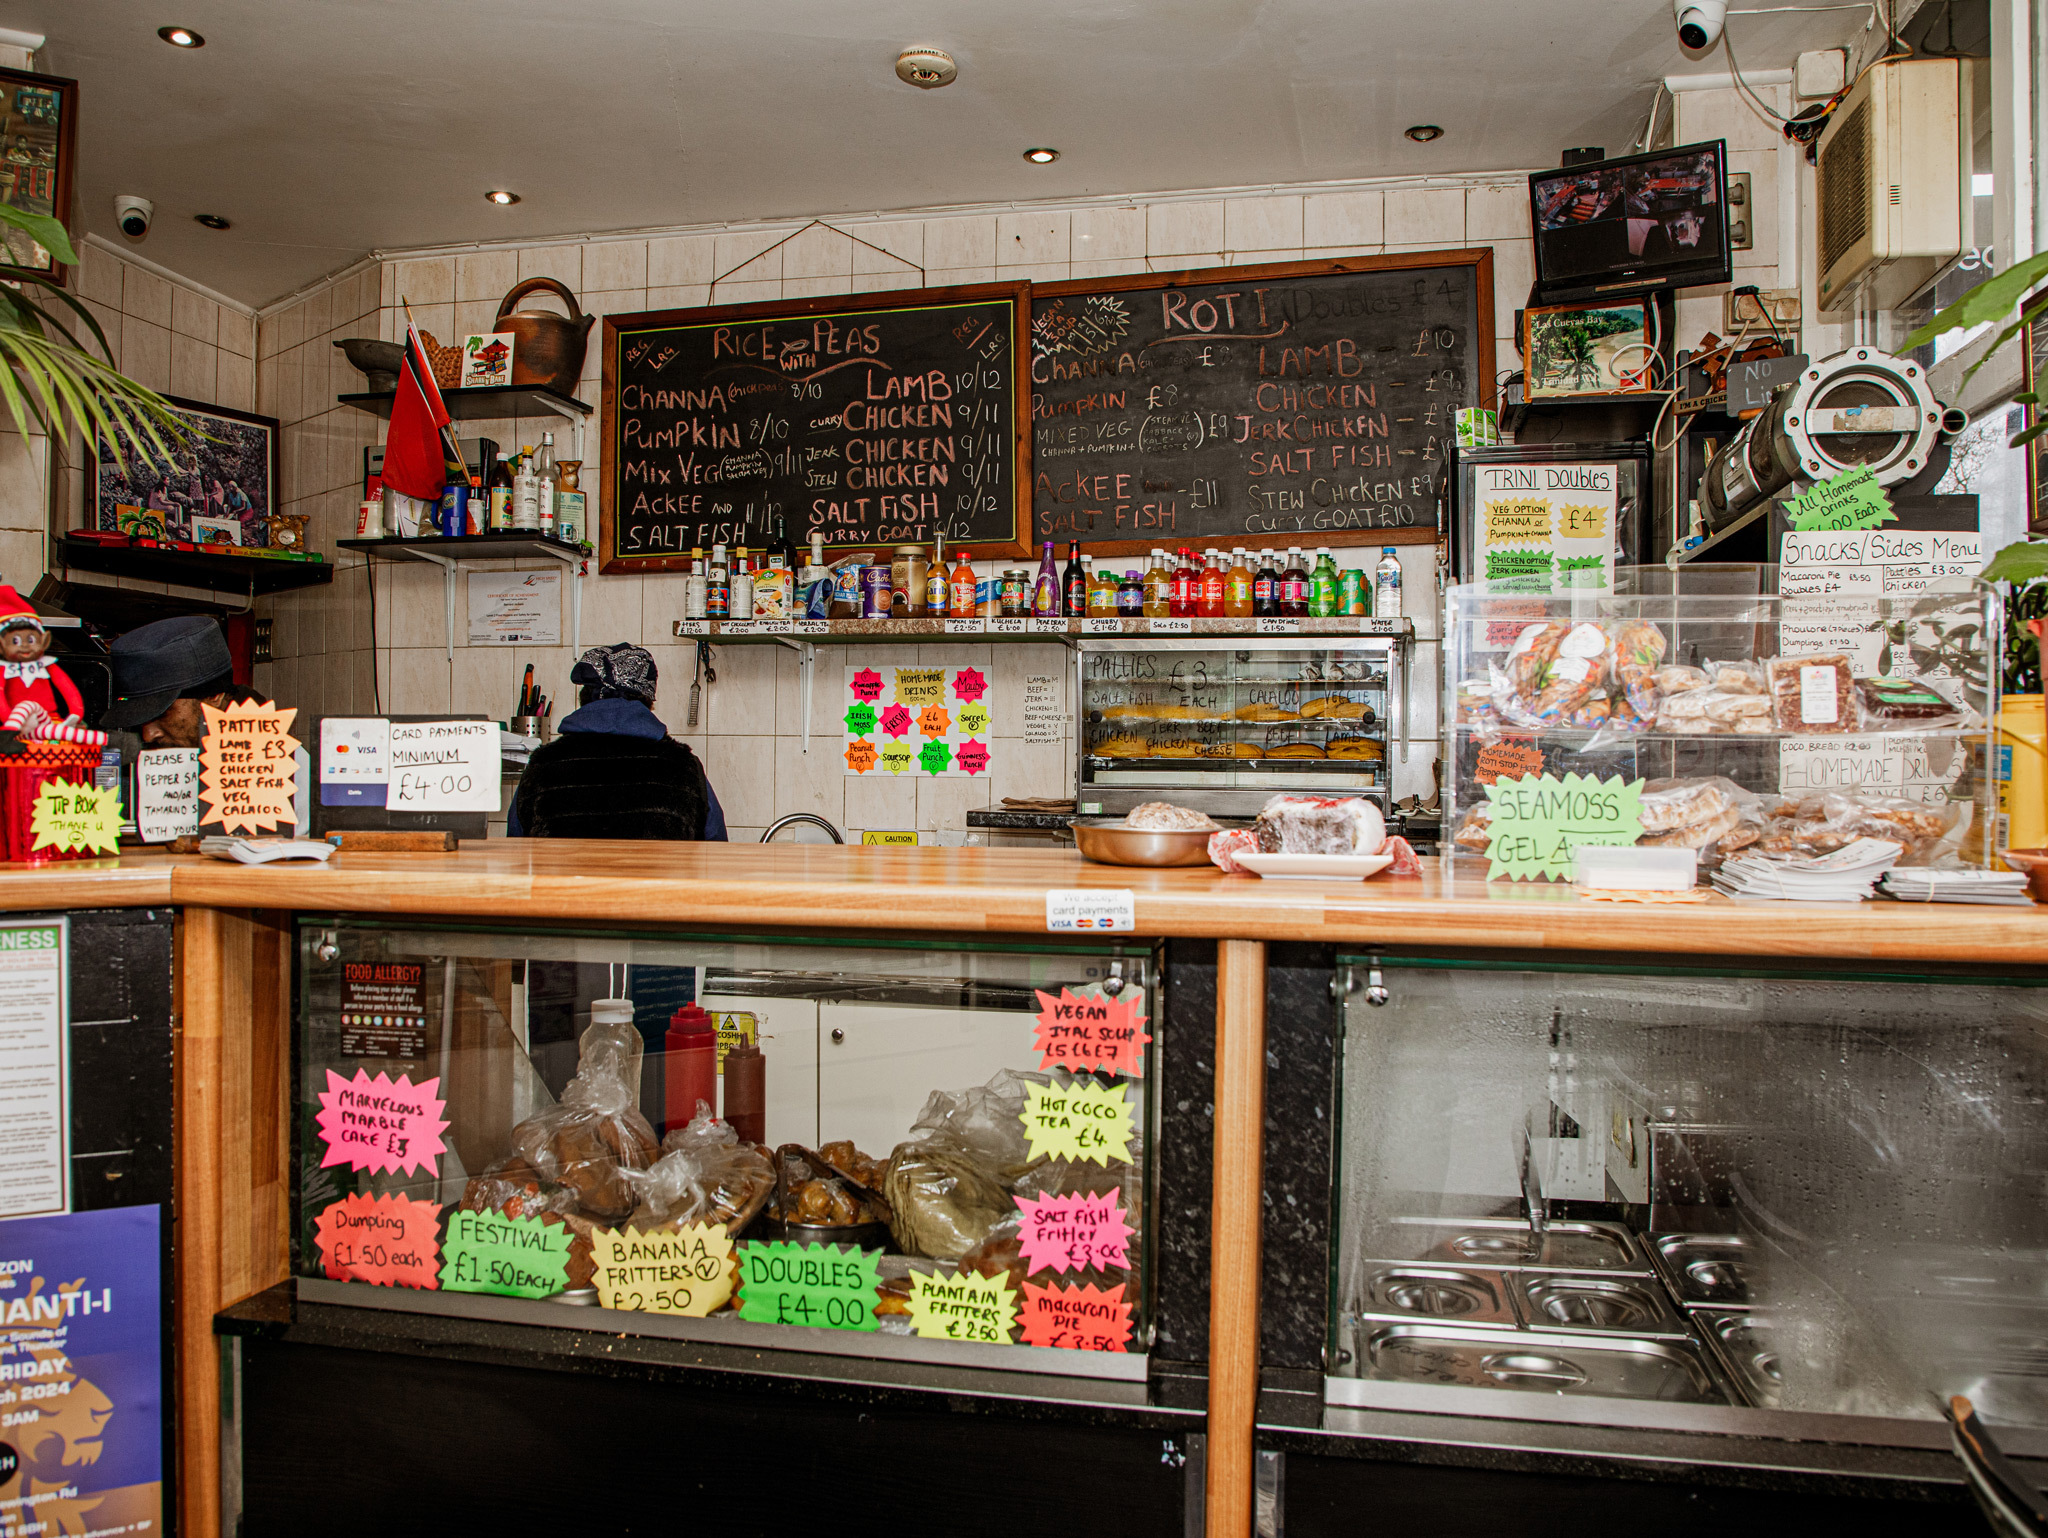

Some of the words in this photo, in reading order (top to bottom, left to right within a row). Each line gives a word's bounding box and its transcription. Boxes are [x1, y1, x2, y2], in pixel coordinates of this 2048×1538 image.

[1536, 320, 1552, 330] Las
[1553, 316, 1586, 328] Cuevas
[1587, 315, 1604, 326] Bay
[713, 326, 777, 360] RICE
[813, 318, 881, 355] PEAS
[1259, 338, 1365, 378] LAMB
[1542, 374, 1579, 386] Trinidad
[1745, 361, 1772, 382] NO
[866, 368, 953, 403] LAMB
[1256, 382, 1377, 413] CHICKEN
[1679, 402, 1691, 410] I'M
[809, 413, 843, 430] CURRY
[843, 400, 953, 432] CHICKEN
[1037, 426, 1090, 444] MIXED
[1096, 420, 1133, 438] VEG
[1294, 412, 1390, 443] CHICKEN
[804, 445, 840, 463] JERK
[846, 435, 956, 464] CHICKEN
[1248, 447, 1316, 476] SALT
[1331, 444, 1392, 468] FISH
[804, 468, 838, 488] STEW
[846, 463, 950, 490] CHICKEN
[1485, 468, 1538, 488] TRINI
[1248, 484, 1304, 513] STEW
[711, 502, 734, 515] AND
[808, 497, 872, 525] SALT
[1493, 505, 1510, 514] VEG
[1513, 505, 1546, 514] OPTION
[1040, 509, 1103, 536] SALT
[1313, 507, 1376, 530] GOAT
[1491, 517, 1531, 527] CHANNA
[1568, 509, 1597, 530] £4
[627, 524, 690, 551] SALT
[697, 523, 747, 545] FISH
[877, 523, 928, 543] GOAT
[1932, 537, 1981, 558] Menu
[1491, 556, 1525, 566] CHICKEN
[1526, 557, 1550, 566] OPTION
[1885, 565, 1922, 576] Patties
[1931, 564, 1964, 575] £3.00
[1491, 567, 1509, 575] JERK
[1511, 567, 1540, 575] CHICKEN
[1781, 571, 1825, 582] Macaroni
[1827, 570, 1841, 580] Pie
[1169, 621, 1189, 629] £2.50
[1782, 638, 1824, 647] Dumplings
[904, 685, 938, 697] DRINKS
[1180, 695, 1217, 708] EACH
[218, 719, 280, 735] PATTIES
[885, 710, 908, 733] FRESH
[924, 723, 941, 732] EACH
[392, 728, 423, 740] CARD
[429, 724, 487, 736] PAYMENTS
[219, 739, 252, 750] LAMB
[261, 740, 286, 759] £3
[357, 746, 377, 755] VISA
[392, 748, 460, 764] MINIMUM
[923, 743, 941, 752] Fruit
[1194, 744, 1233, 756] CHEESE
[1482, 748, 1526, 762] HOMEMADE
[1782, 743, 1805, 751] COCO
[144, 753, 185, 766] PLEASE
[221, 752, 254, 763] BEEF
[922, 752, 944, 762] Punch
[1480, 756, 1497, 767] ROTI
[1499, 759, 1519, 769] STOP
[1520, 764, 1538, 773] HOT
[219, 764, 275, 776] CHICKEN
[1783, 757, 1894, 787] HOMEMADE
[145, 774, 180, 785] PEPPER
[220, 778, 252, 789] SALT
[256, 777, 285, 788] FISH
[399, 772, 472, 801] £4.00
[163, 789, 192, 801] AND/OR
[223, 792, 250, 804] VEG
[50, 796, 69, 815] TIP
[74, 795, 99, 813] BOX
[145, 805, 188, 816] TAMARIND
[1499, 790, 1621, 821] SEAMOSS
[50, 820, 89, 831] THANK
[144, 824, 168, 836] WITH
[885, 835, 913, 843] CAUTION
[1496, 834, 1546, 863] GEL
[1052, 904, 1076, 915] card
[1078, 906, 1129, 918] payments
[1051, 919, 1073, 928] VISA
[345, 963, 372, 979] FOOD
[375, 965, 421, 982] ALLERGY?
[1054, 1004, 1108, 1020] VEGAN
[1049, 1026, 1092, 1040] ITAL
[338, 1089, 425, 1118] MARVELOUS
[1040, 1096, 1067, 1112] HOT
[1072, 1100, 1117, 1119] COCO
[342, 1111, 406, 1130] MARBLE
[1036, 1115, 1070, 1128] TEA
[342, 1129, 379, 1146] CAKE
[1075, 1128, 1107, 1148] £4
[460, 1219, 560, 1253] FESTIVAL
[333, 1242, 388, 1267] £1.50
[391, 1249, 423, 1267] each
[612, 1237, 708, 1263] BANANA
[454, 1251, 514, 1287] £1.50
[515, 1269, 556, 1292] EACH
[606, 1264, 694, 1288] FRITTERS
[751, 1254, 863, 1290] DOUBLES
[922, 1282, 998, 1306] PLANTAIN
[777, 1293, 864, 1326] £4.00
[929, 1301, 1001, 1326] FRITTERS
[20, 1381, 71, 1401] 2024
[1, 1410, 39, 1427] 3AM
